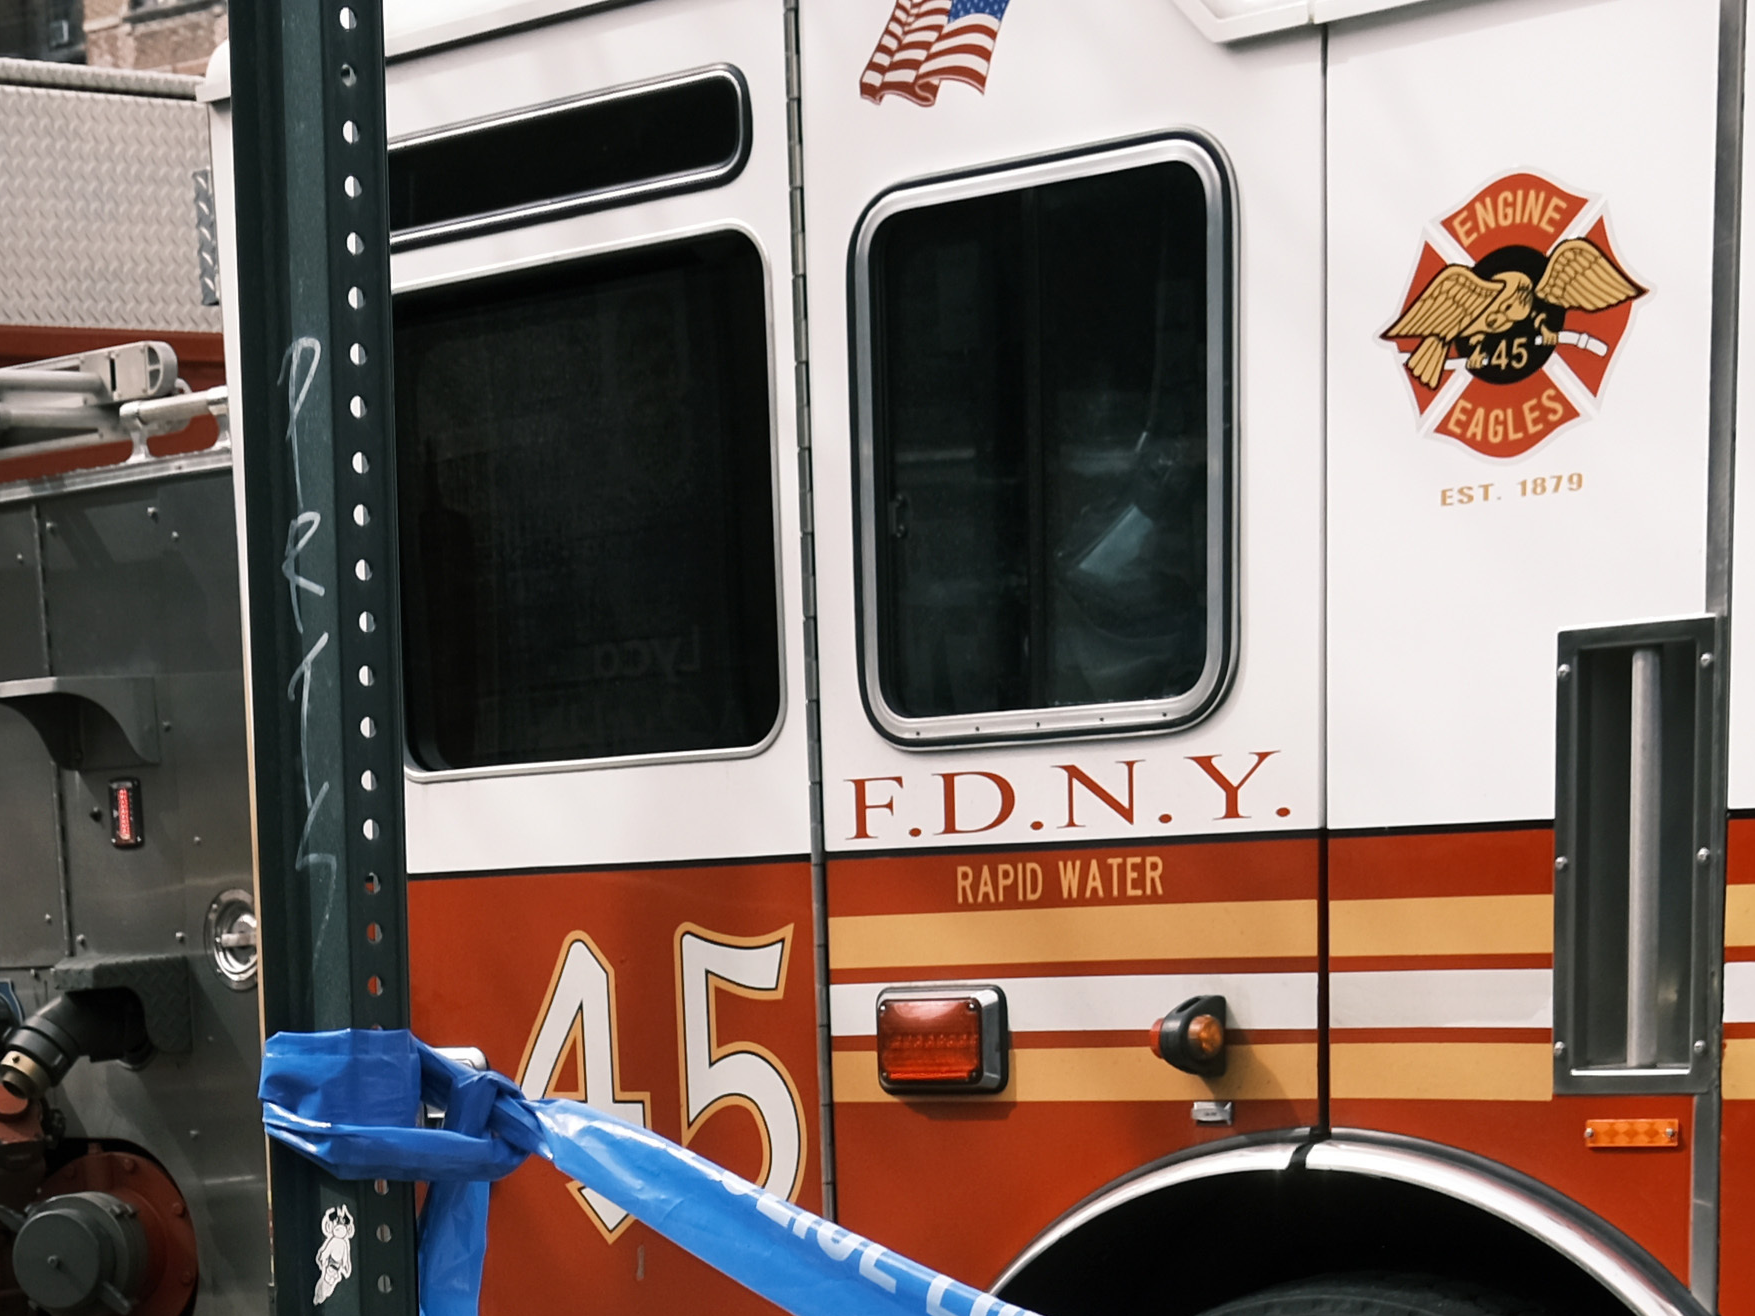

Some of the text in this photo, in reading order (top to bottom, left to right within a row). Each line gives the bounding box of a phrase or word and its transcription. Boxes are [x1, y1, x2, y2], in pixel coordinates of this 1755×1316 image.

[1452, 189, 1568, 248] ENGINE
[1490, 337, 1528, 370] 45
[1448, 388, 1564, 444] EAGLES
[1440, 472, 1584, 506] EST. 1879
[844, 750, 1291, 840] F.D.N.Y.
[956, 855, 1164, 904] RAPID WATER
[514, 921, 807, 1246] 45
